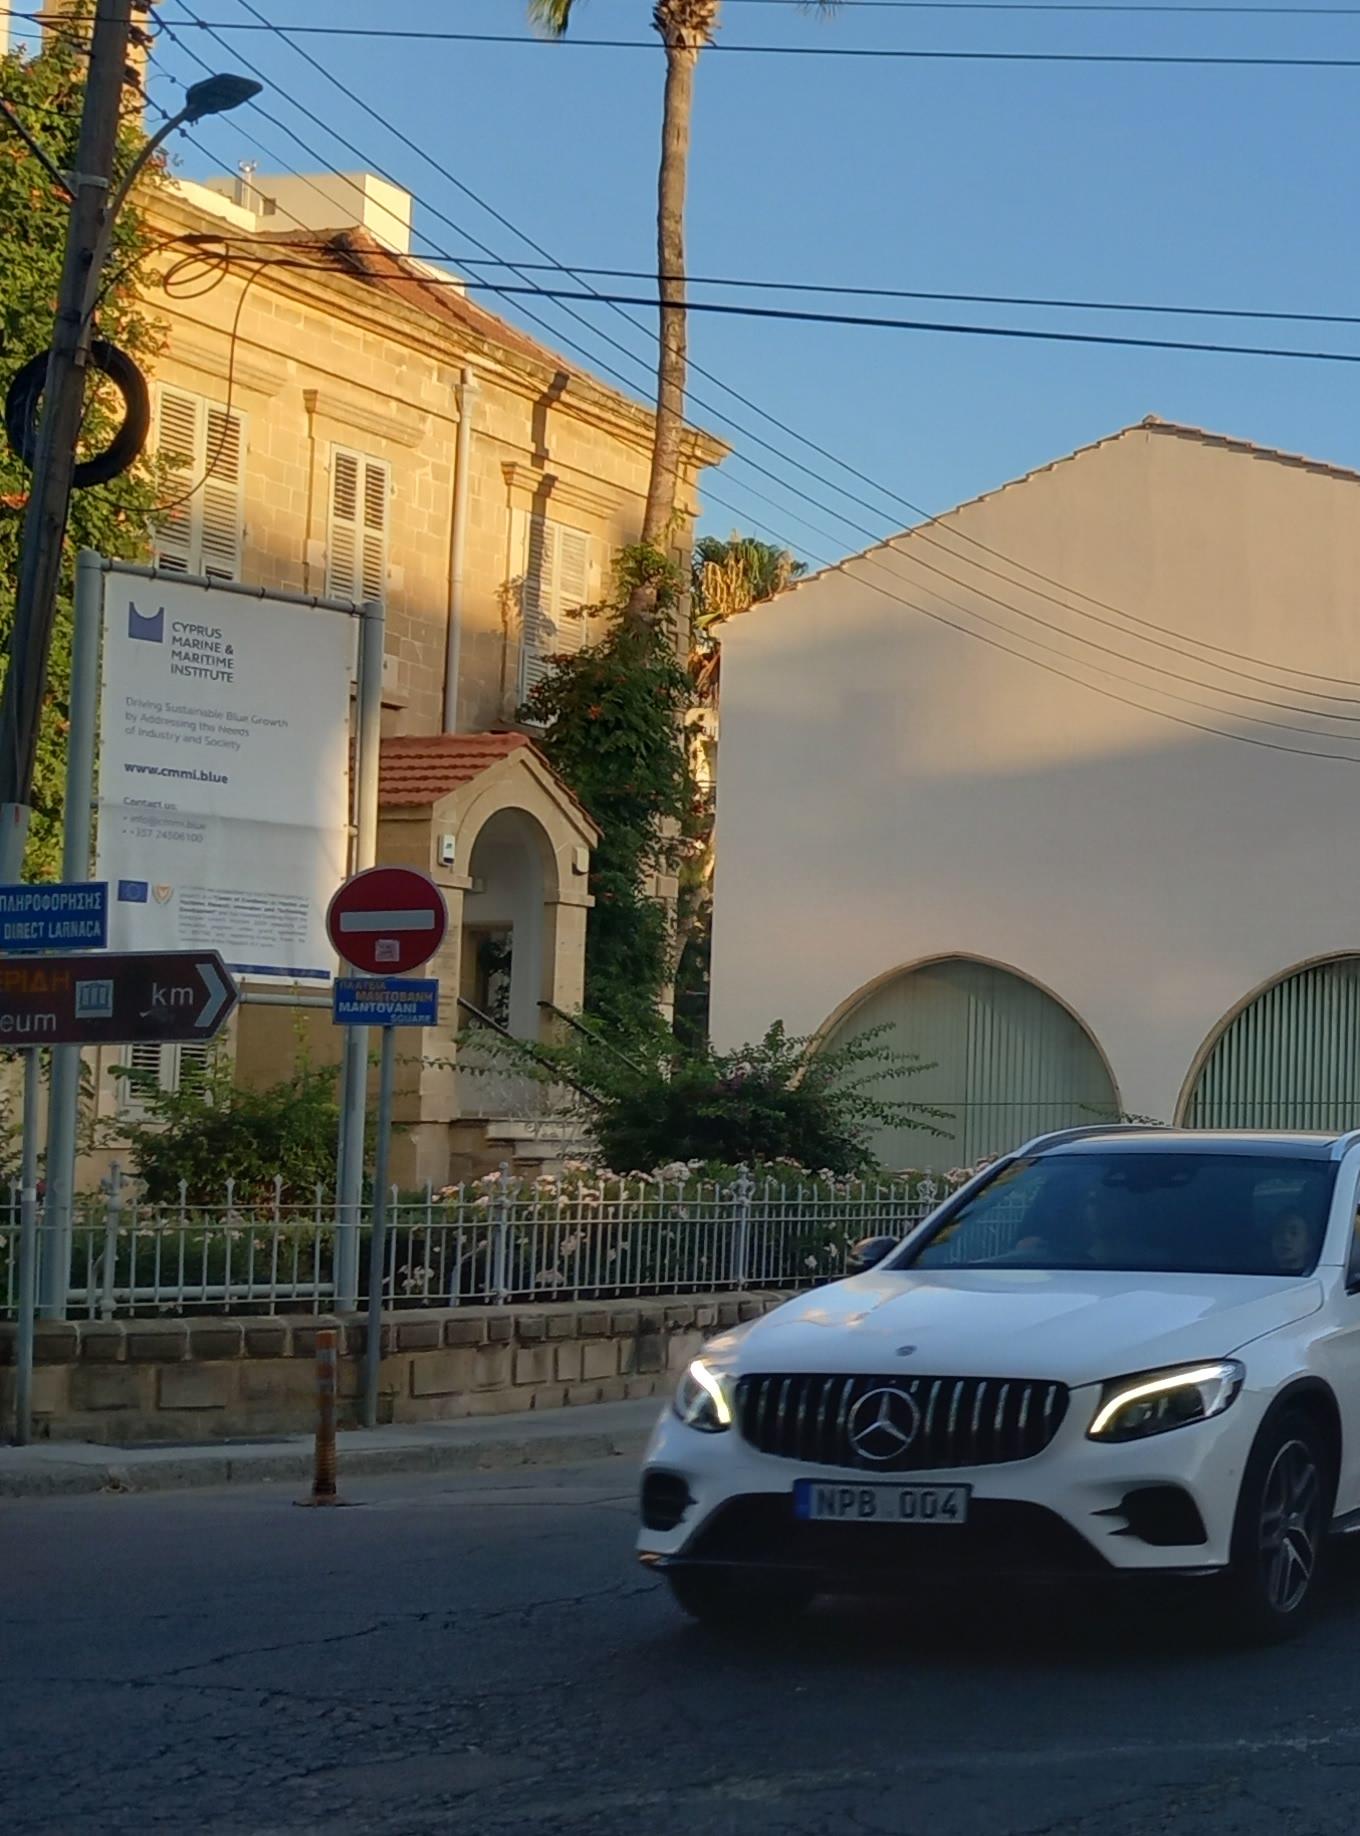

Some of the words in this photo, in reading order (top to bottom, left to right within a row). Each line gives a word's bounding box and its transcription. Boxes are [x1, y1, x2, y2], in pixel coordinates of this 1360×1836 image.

[172, 621, 222, 639] CYPRUS
[172, 635, 221, 653] MARINE
[225, 645, 234, 655] &
[171, 650, 234, 669] MARITIME
[170, 663, 234, 683] INSTITUTE
[126, 696, 162, 712] Driving
[165, 702, 223, 721] Sustainable
[226, 711, 248, 722] Blue
[250, 714, 288, 728] Growth
[125, 712, 137, 723] by
[139, 714, 196, 732] Addressing
[199, 722, 215, 732] the
[218, 725, 250, 737] Needs
[125, 726, 135, 736] of
[138, 727, 180, 744] Industry
[183, 733, 202, 744] and
[204, 736, 241, 750] Society
[124, 762, 229, 784] www.cmmi.blue
[123, 796, 162, 809] Contact
[4, 922, 44, 940] DIRECT
[49, 921, 101, 938] LARNACA
[0, 968, 70, 992] ΡΙΔΗ
[152, 983, 194, 1006] km
[338, 1002, 417, 1013] MANTOVANI
[390, 1014, 432, 1025] SQUARE
[817, 1488, 876, 1518] NPB
[900, 1489, 958, 1519] 004
